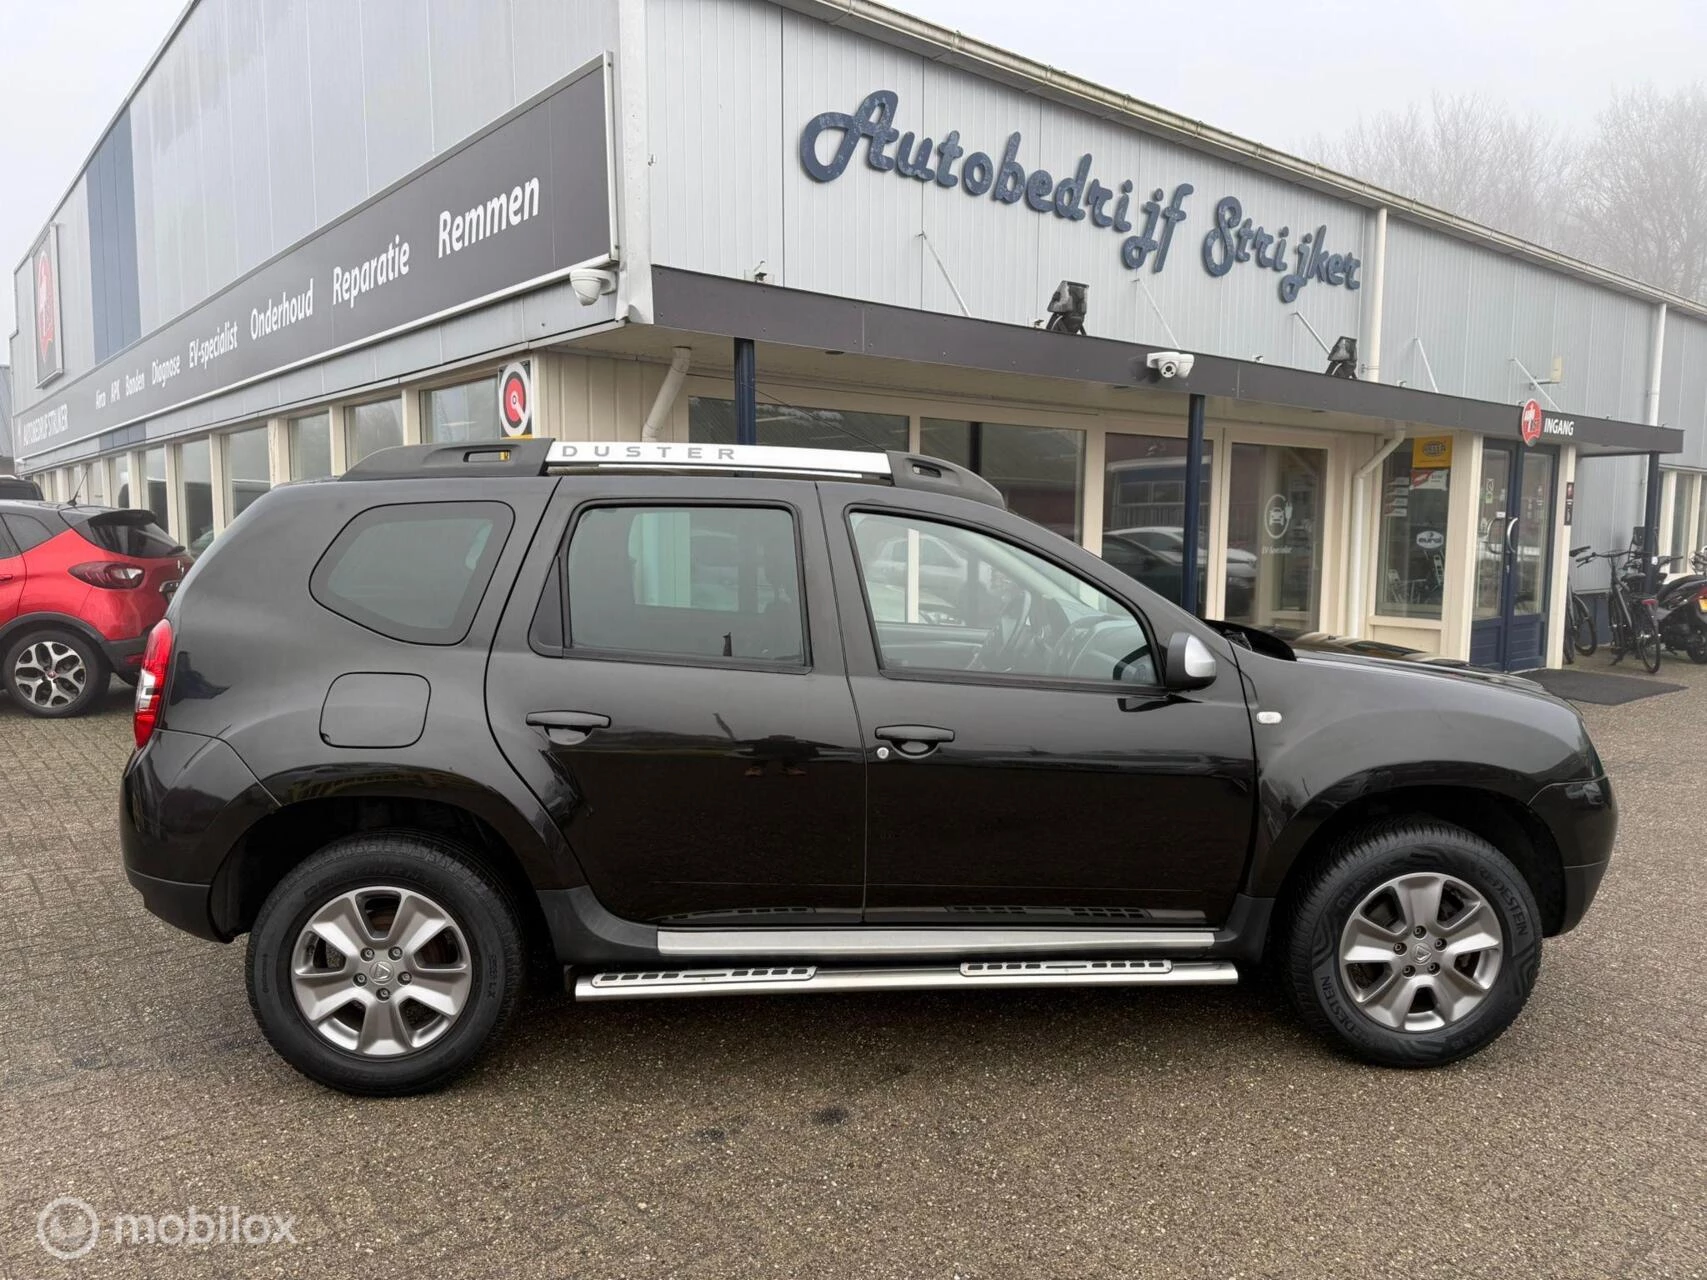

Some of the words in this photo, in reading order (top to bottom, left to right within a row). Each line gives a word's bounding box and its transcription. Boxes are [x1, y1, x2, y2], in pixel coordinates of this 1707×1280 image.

[798, 89, 1194, 273] Autobedrijf
[1203, 195, 1361, 303] Strijker
[110, 379, 121, 403] APK
[125, 369, 145, 397] Banden
[152, 355, 181, 388] Diagnose
[189, 320, 238, 370] EV-specialist
[250, 278, 314, 341] Onderhoud
[332, 234, 410, 309] Reparatie
[438, 177, 540, 259] Remmen
[562, 445, 735, 460] DUSTER
[1543, 417, 1575, 437] INGANG
[1476, 864, 1529, 937] REDESTEIN
